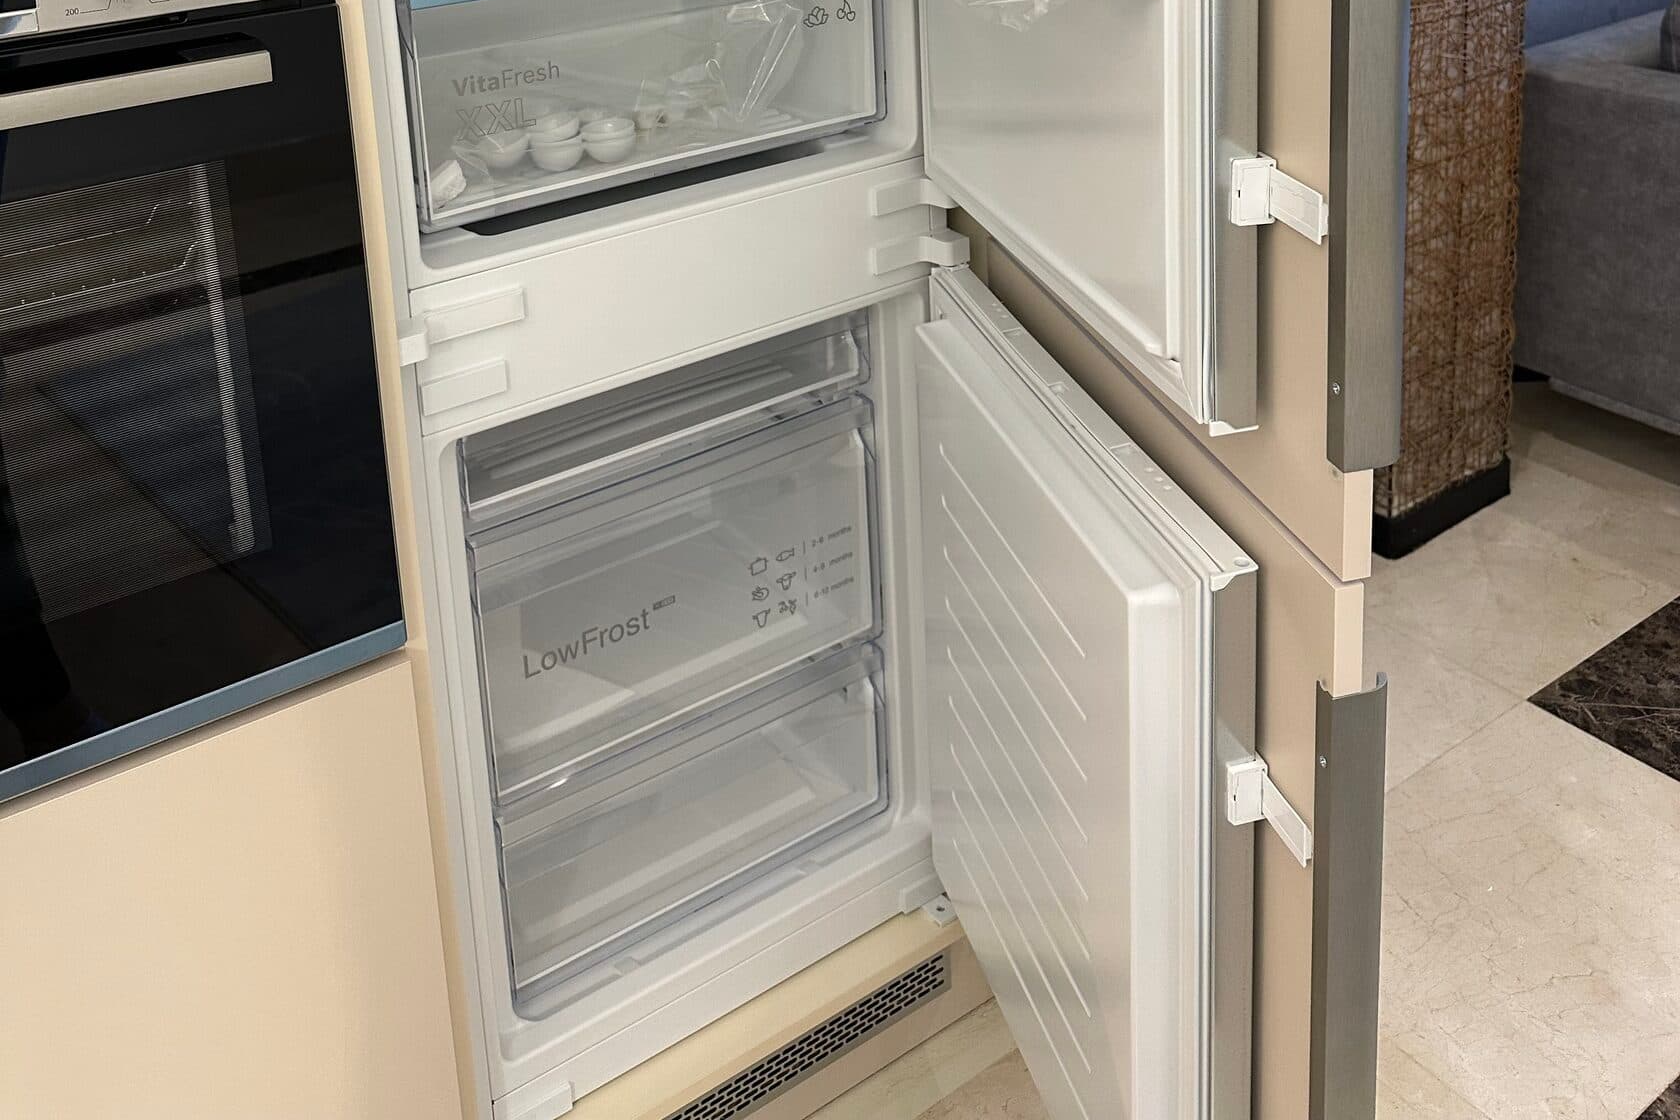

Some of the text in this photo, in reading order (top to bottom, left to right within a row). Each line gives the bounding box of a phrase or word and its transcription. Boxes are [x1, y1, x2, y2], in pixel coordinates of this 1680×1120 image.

[65, 7, 80, 17] 200
[451, 60, 561, 97] VitaFresh
[455, 97, 538, 141] XXL
[522, 608, 651, 679] LowFrost
